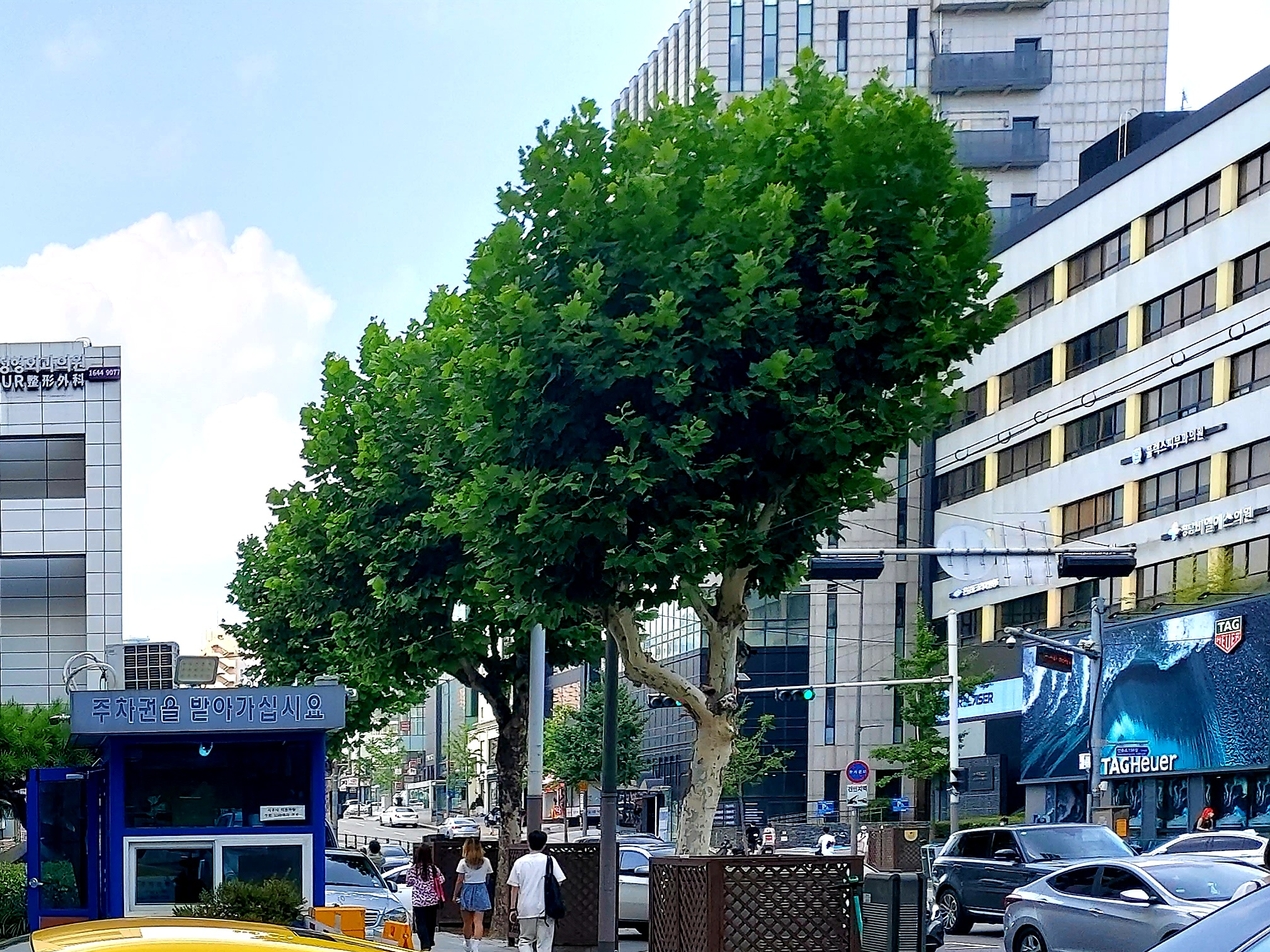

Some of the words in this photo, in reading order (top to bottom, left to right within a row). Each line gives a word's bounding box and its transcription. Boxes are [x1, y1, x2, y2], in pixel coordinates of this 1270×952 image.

[1217, 618, 1240, 633] TAG
[92, 695, 180, 724] 주차권을
[189, 693, 325, 723] 받아가십시요
